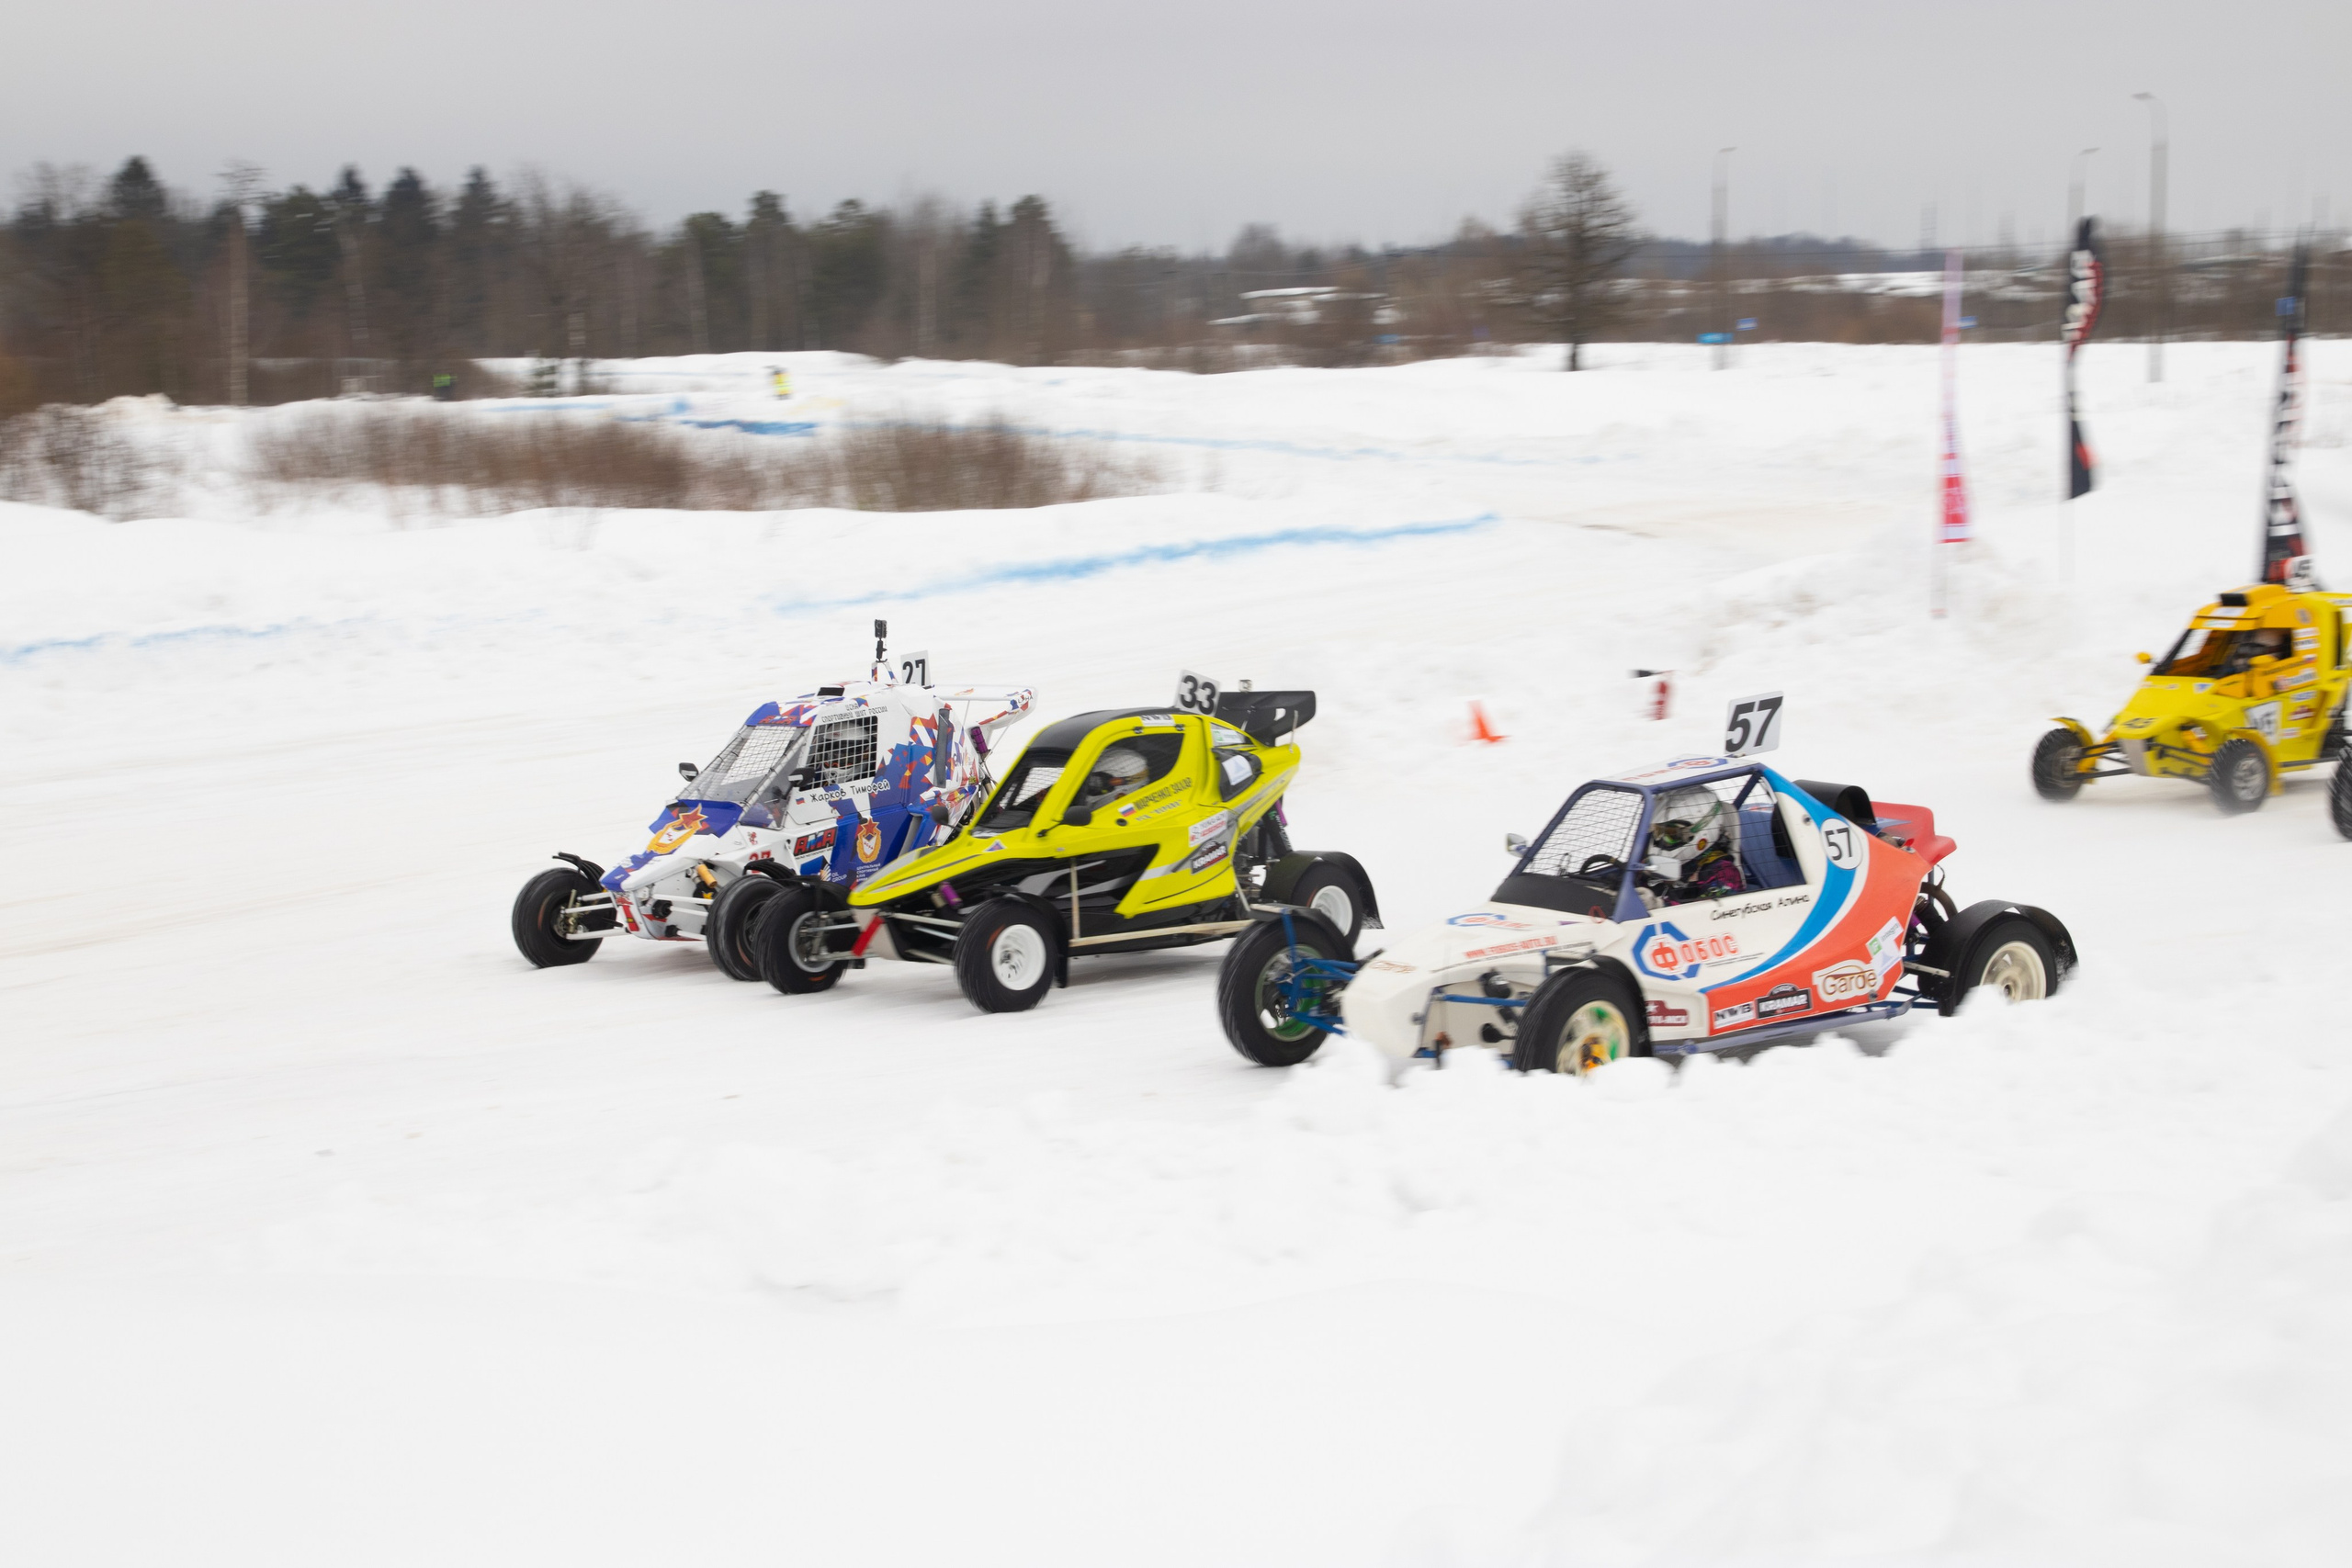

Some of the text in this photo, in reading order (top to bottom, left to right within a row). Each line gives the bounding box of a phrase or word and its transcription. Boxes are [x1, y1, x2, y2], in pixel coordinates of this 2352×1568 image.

[902, 659, 926, 686] 27
[1181, 675, 1216, 715] 33
[1725, 696, 1783, 752] 57
[810, 780, 890, 803] Жарков Тимофей
[1825, 827, 1852, 861] 57
[1777, 895, 1811, 908] Алина
[1652, 934, 1739, 971] ФОБОС
